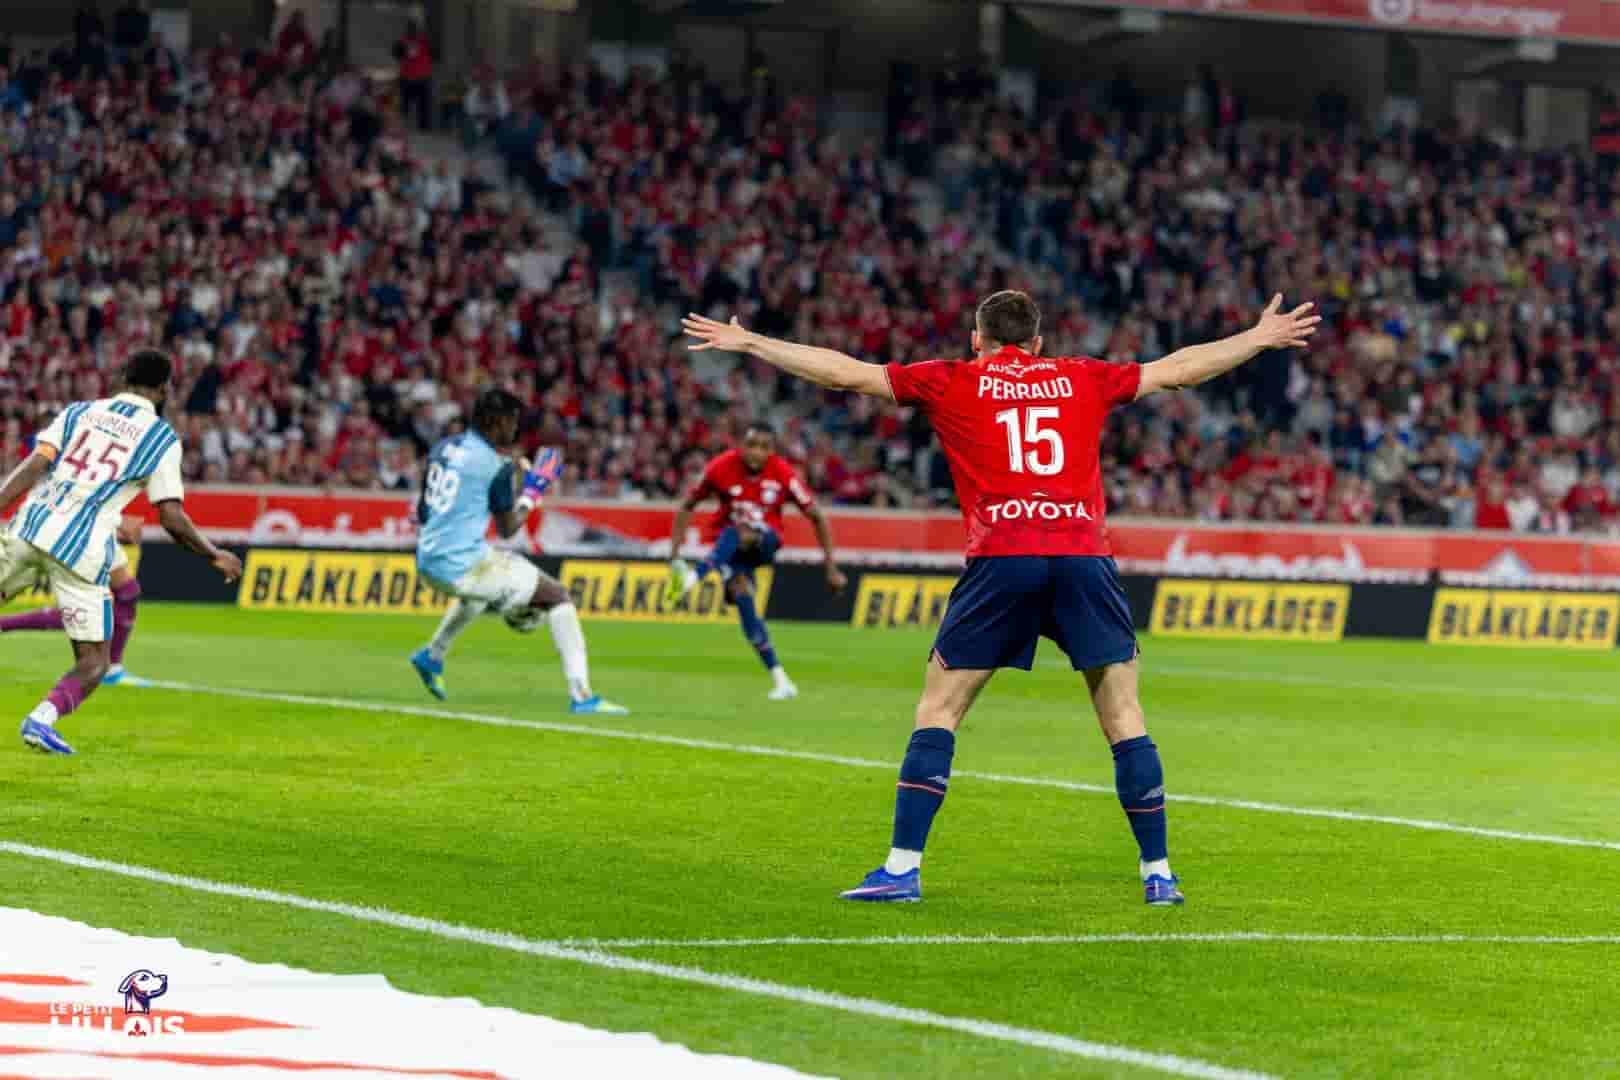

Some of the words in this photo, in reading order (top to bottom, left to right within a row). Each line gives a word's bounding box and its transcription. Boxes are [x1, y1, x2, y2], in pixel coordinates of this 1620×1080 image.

[977, 375, 1073, 400] PERRAUD
[63, 429, 128, 482] 45
[995, 406, 1064, 476] 15
[424, 462, 460, 513] 99
[986, 498, 1093, 523] TOYOTA
